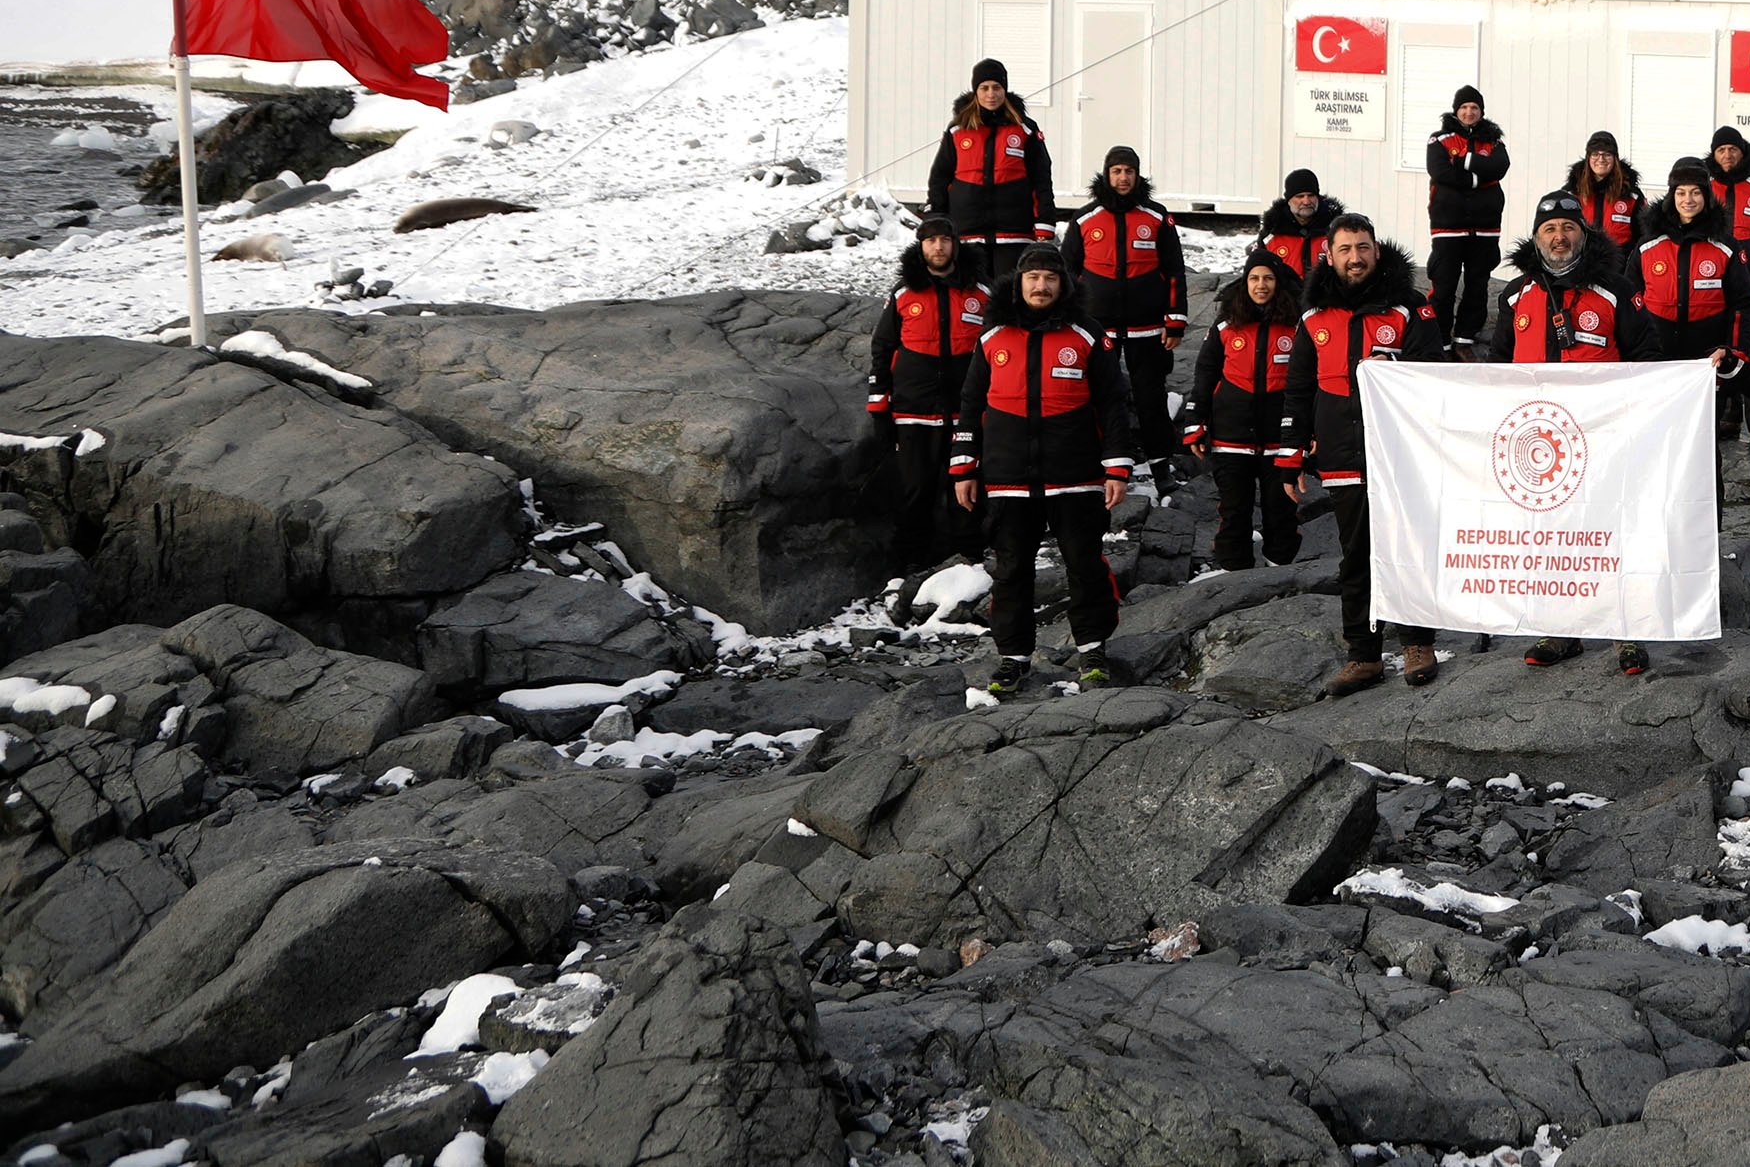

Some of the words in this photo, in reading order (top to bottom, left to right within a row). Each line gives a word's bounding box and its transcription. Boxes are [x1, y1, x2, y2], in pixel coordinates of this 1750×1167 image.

[1310, 88, 1330, 100] TÜRK
[1333, 88, 1369, 102] BİLİMSEL
[1315, 103, 1364, 115] ARAŞTIRMA
[1327, 118, 1349, 126] KAMPI
[1456, 529, 1530, 546] REPUBLIC
[1533, 530, 1553, 546] OF
[1557, 531, 1612, 547] TURKEY
[1445, 554, 1520, 570] MINISTRY
[1523, 555, 1542, 570] OF
[1545, 556, 1620, 572] INDUSTRY
[1461, 579, 1495, 594] AND
[1499, 579, 1599, 597] TECHNOLOGY
